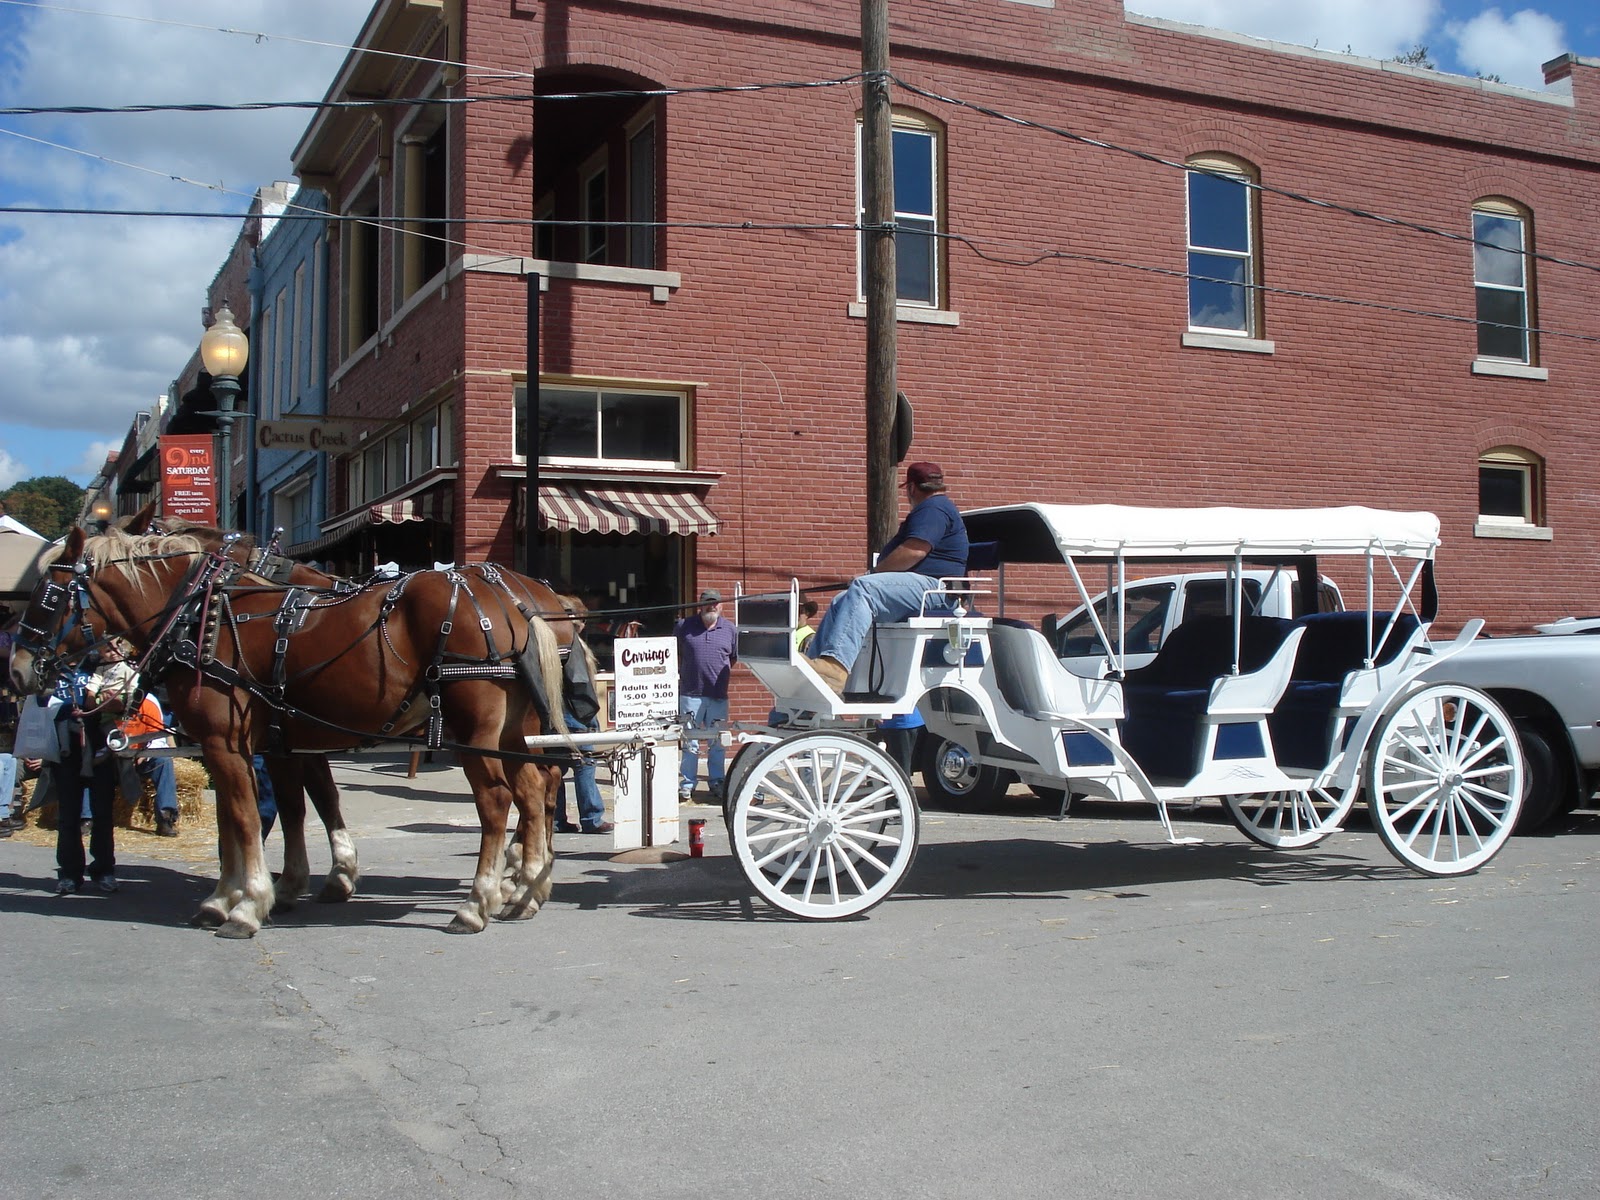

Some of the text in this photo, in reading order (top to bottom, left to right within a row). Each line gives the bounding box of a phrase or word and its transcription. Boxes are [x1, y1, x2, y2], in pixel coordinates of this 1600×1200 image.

[260, 425, 347, 449] Cactus Creek
[166, 447, 209, 487] 2nd
[166, 466, 211, 475] SATURDAY
[621, 648, 671, 668] Carriage
[632, 666, 667, 676] RIDES
[652, 691, 674, 699] $3.00
